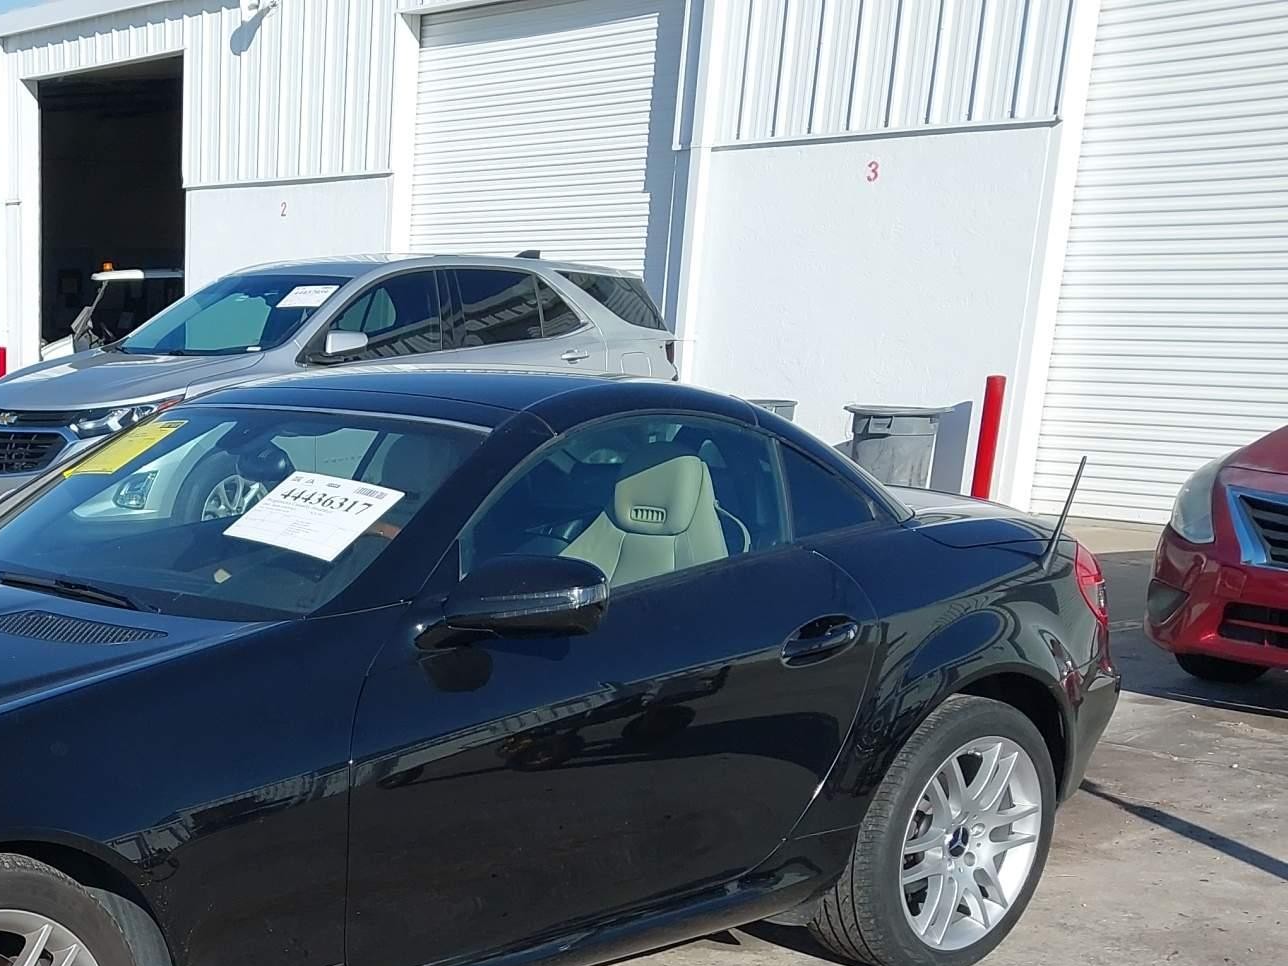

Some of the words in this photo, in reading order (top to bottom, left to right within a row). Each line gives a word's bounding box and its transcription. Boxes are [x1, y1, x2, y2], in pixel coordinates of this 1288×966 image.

[867, 161, 879, 182] 3
[280, 201, 288, 217] 2
[280, 488, 374, 515] 44436317
